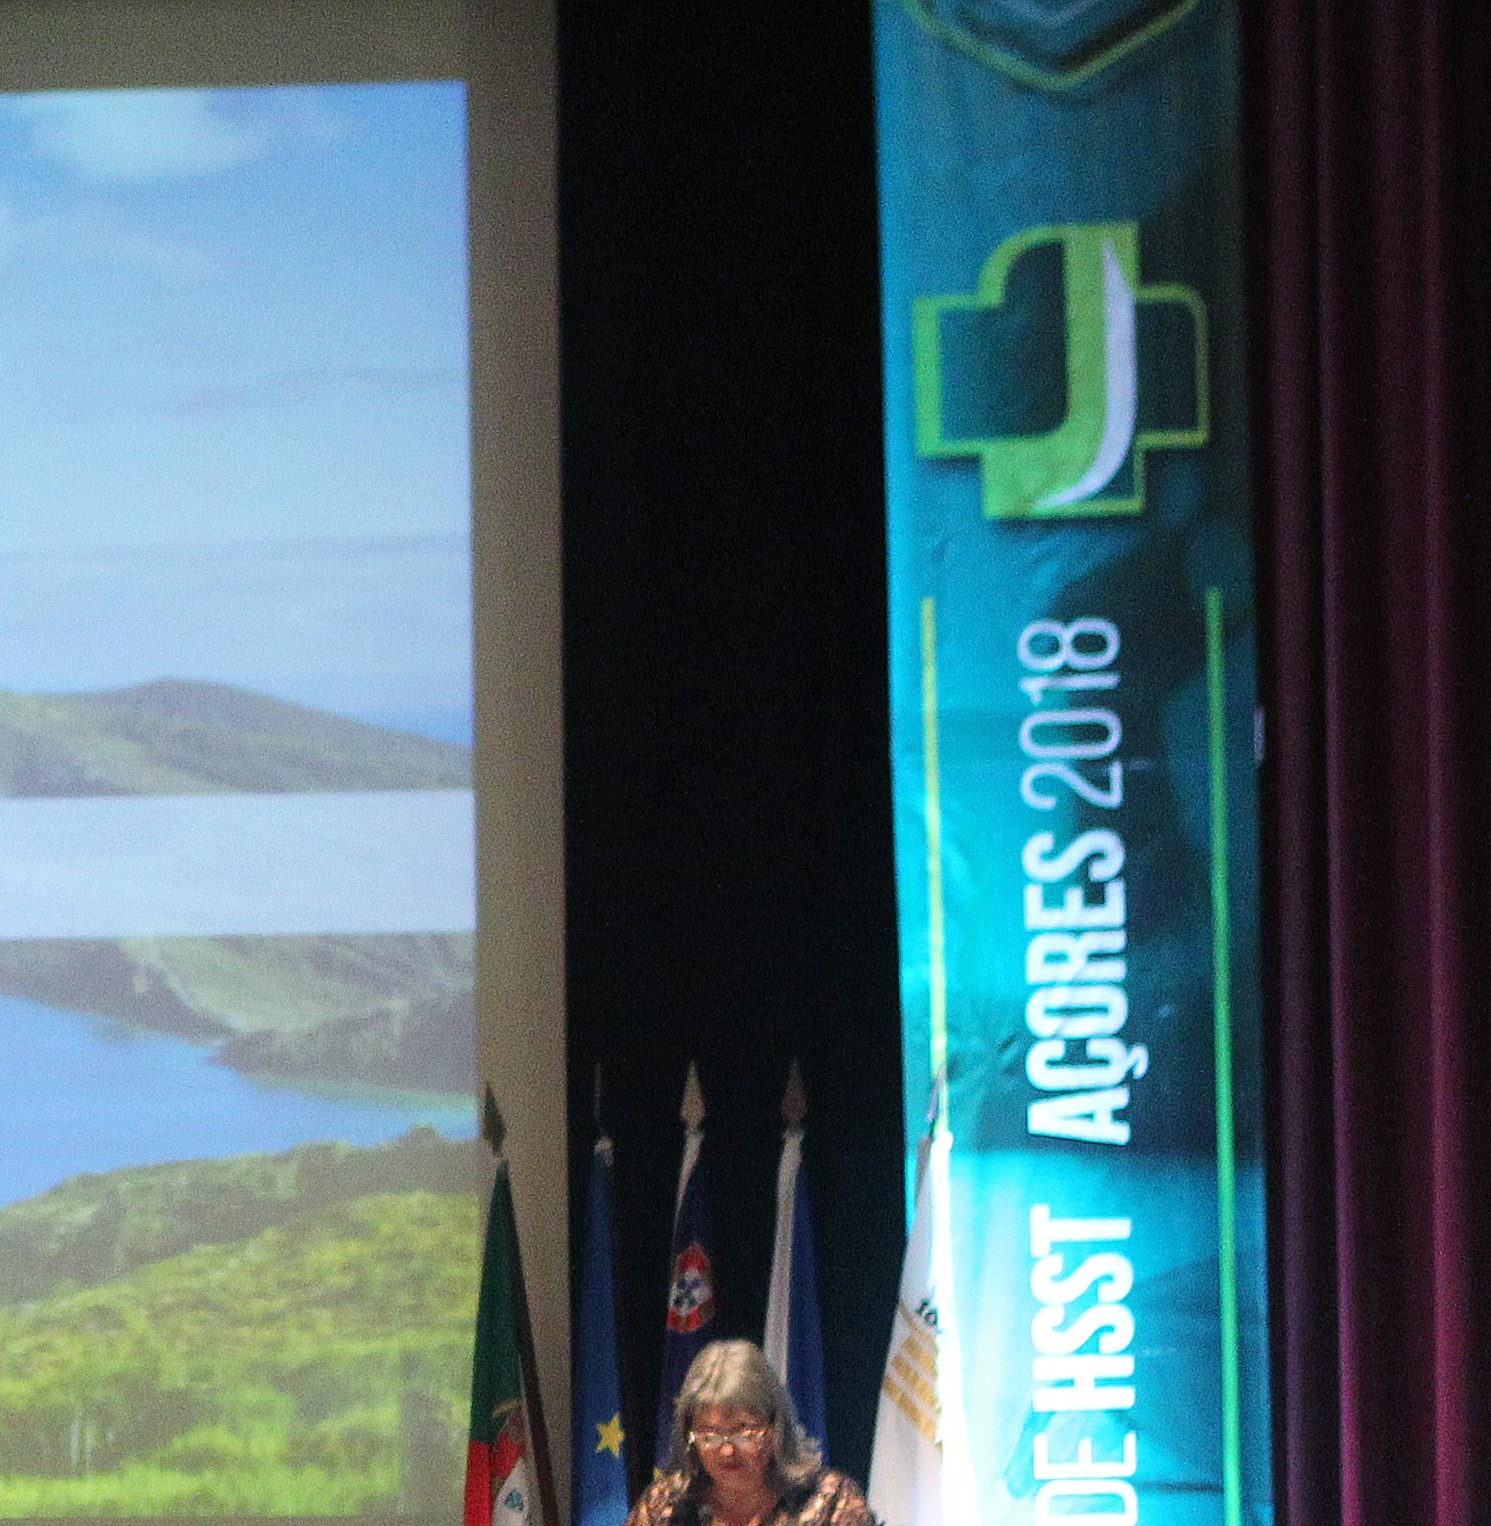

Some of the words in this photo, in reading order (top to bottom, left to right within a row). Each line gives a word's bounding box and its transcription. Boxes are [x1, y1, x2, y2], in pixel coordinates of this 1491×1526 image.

[1018, 614, 1125, 809] 2018
[1022, 827, 1149, 1146] AÇORES
[1029, 1204, 1135, 1416] HSST
